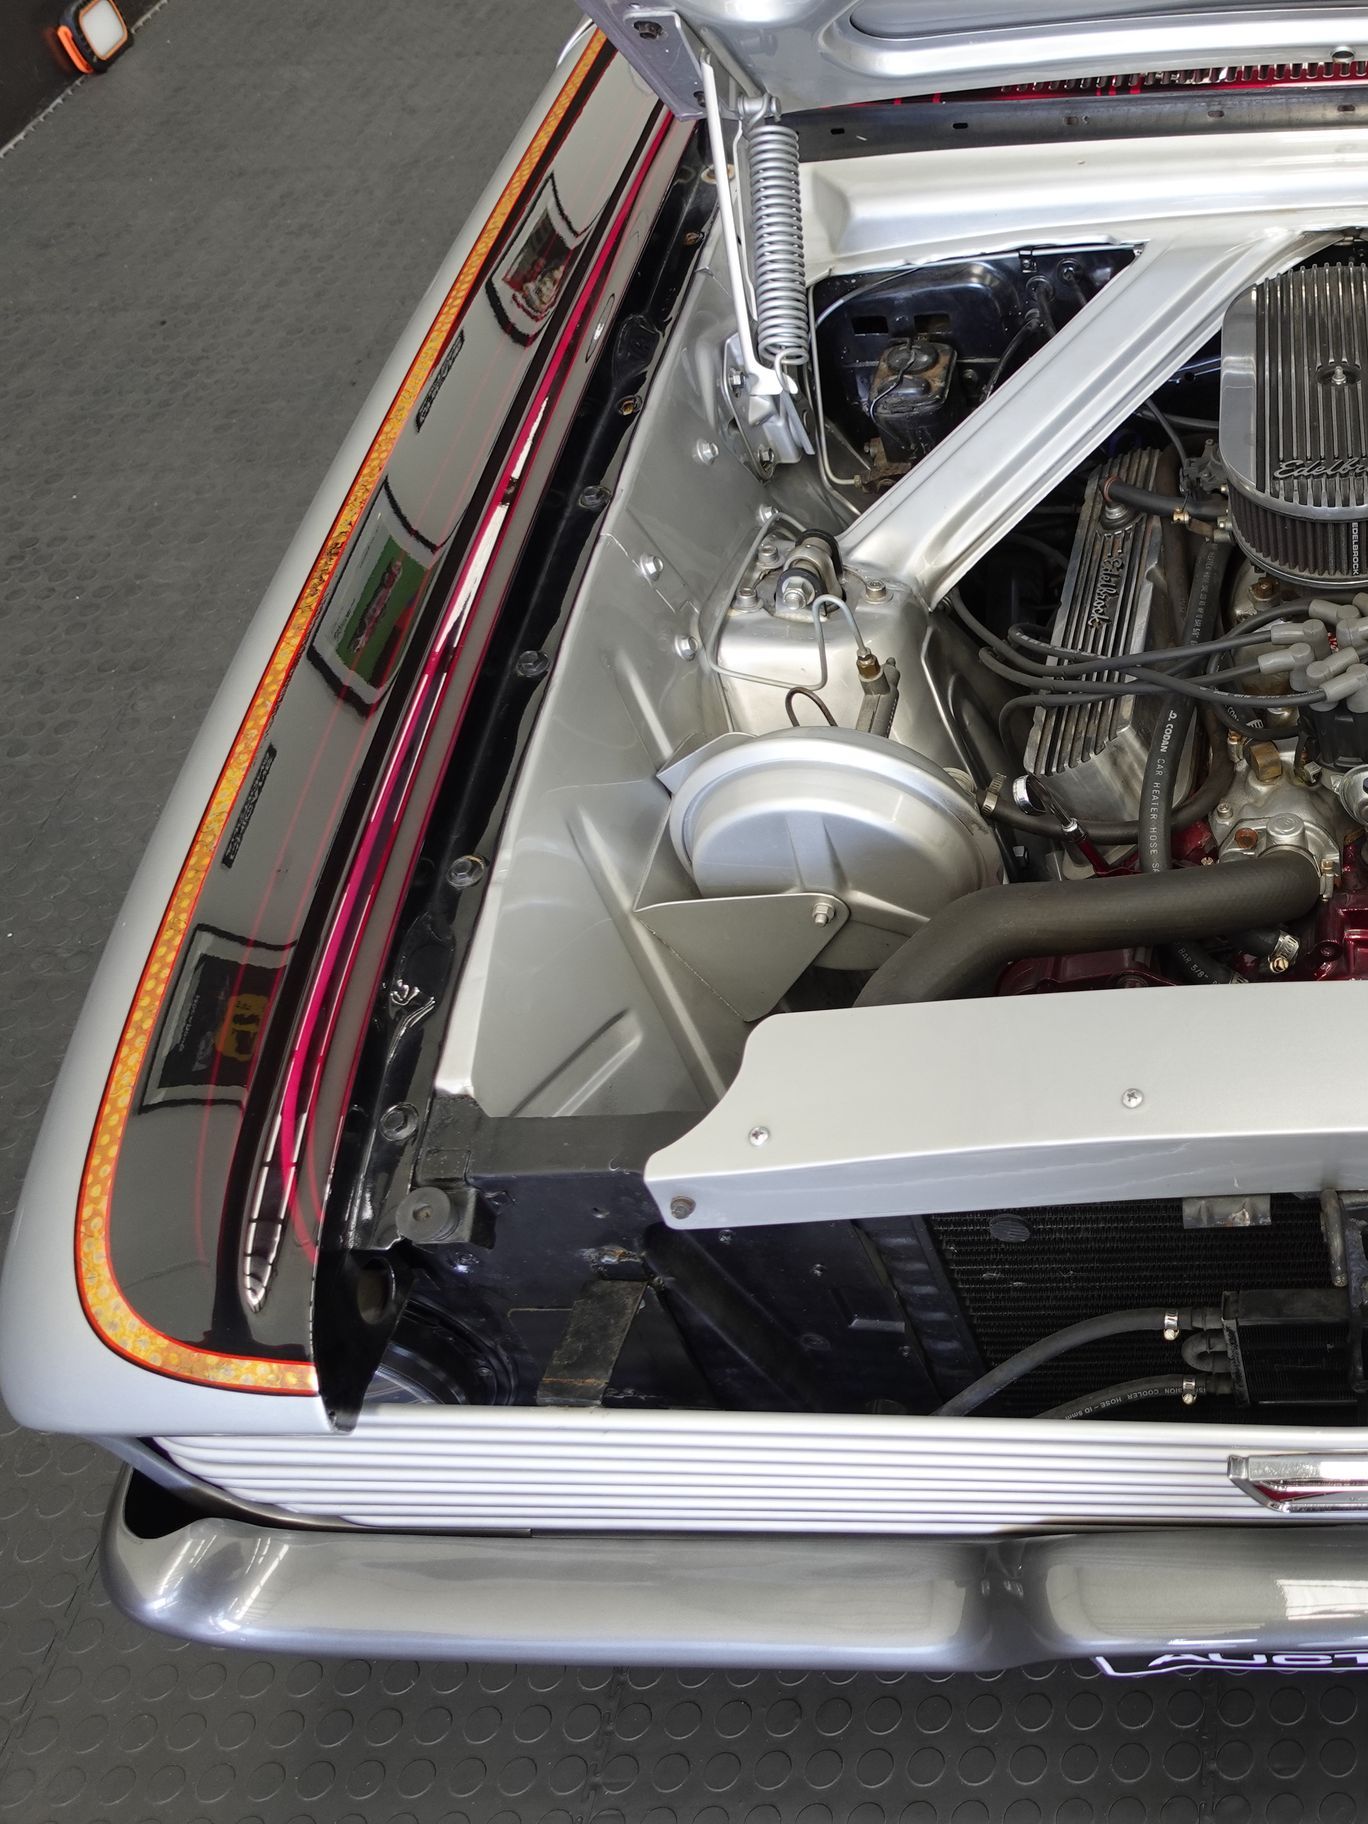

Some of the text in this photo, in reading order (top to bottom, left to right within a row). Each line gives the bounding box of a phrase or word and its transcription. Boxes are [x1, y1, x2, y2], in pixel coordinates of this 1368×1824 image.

[1352, 522, 1360, 576] EDELBROCK
[1088, 557, 1123, 626] Edelbrock
[1160, 723, 1174, 753] CODAN
[1155, 758, 1166, 776] CAR
[1150, 782, 1161, 820] HEATER
[1150, 826, 1159, 855] HOSE
[1100, 1397, 1122, 1409] HOSE
[1127, 1388, 1160, 1400] COOLER
